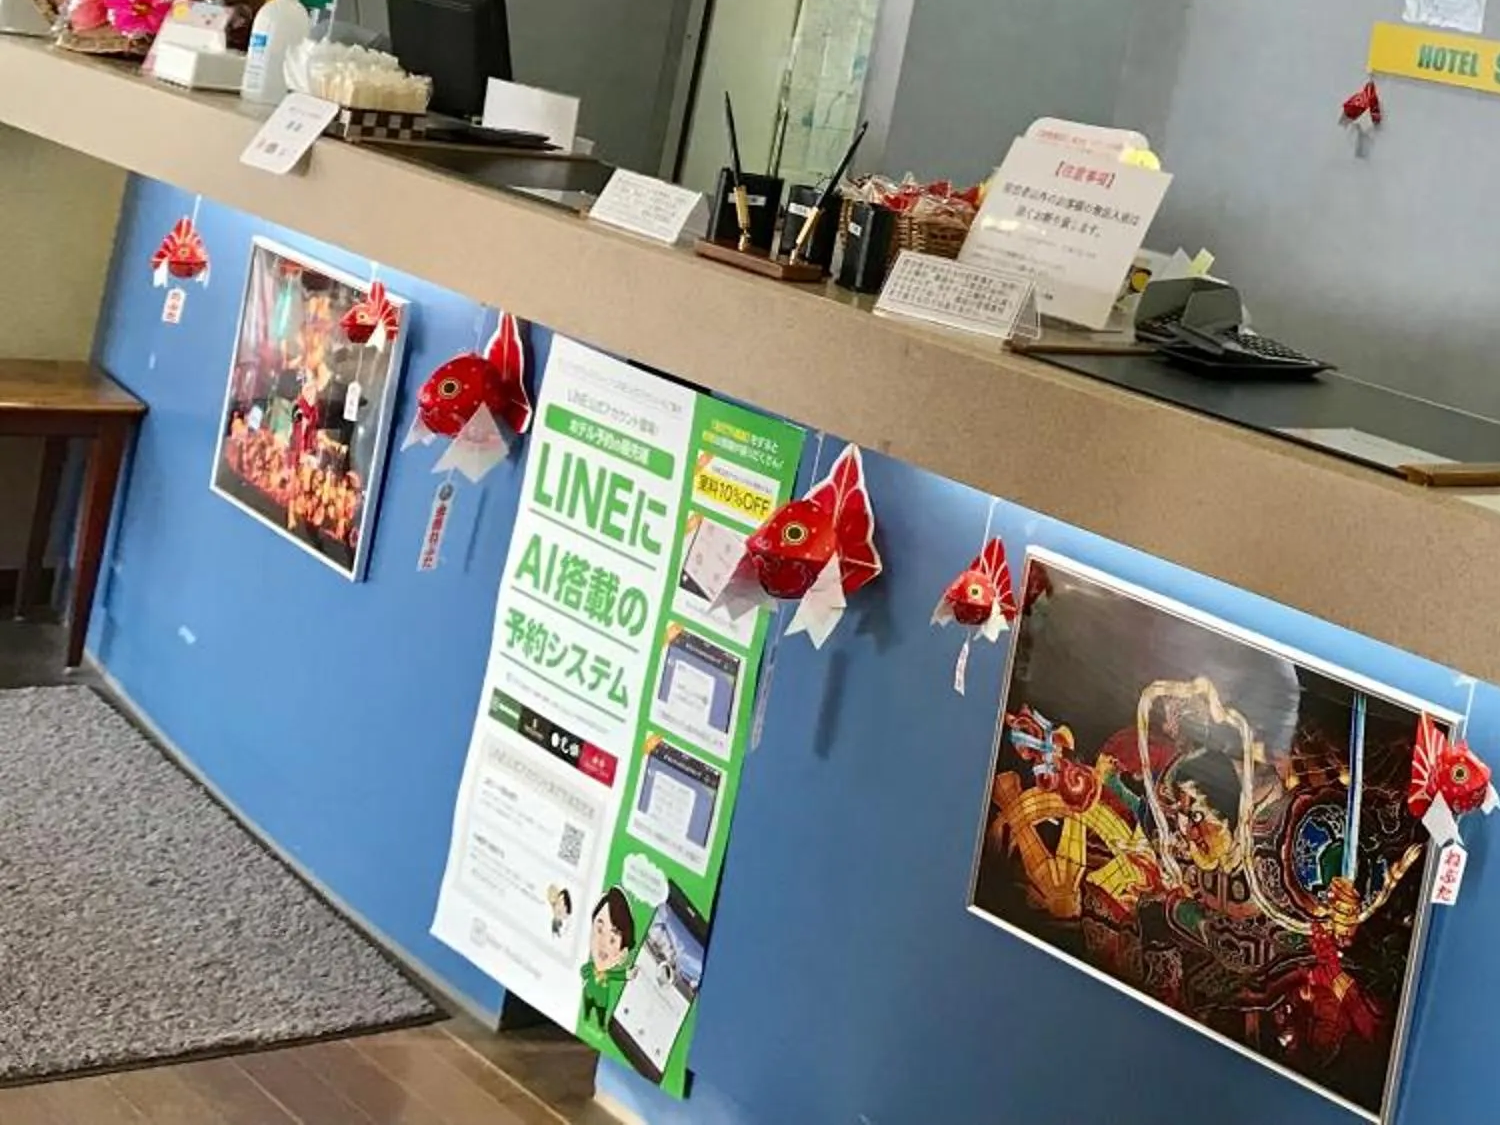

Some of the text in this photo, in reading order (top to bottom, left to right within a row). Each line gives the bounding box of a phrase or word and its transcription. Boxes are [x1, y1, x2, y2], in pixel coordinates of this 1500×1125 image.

[1417, 43, 1480, 78] HOTEL
[532, 441, 668, 556] LINEに
[514, 533, 648, 637] AI搭載の
[504, 606, 629, 709] 予約システム
